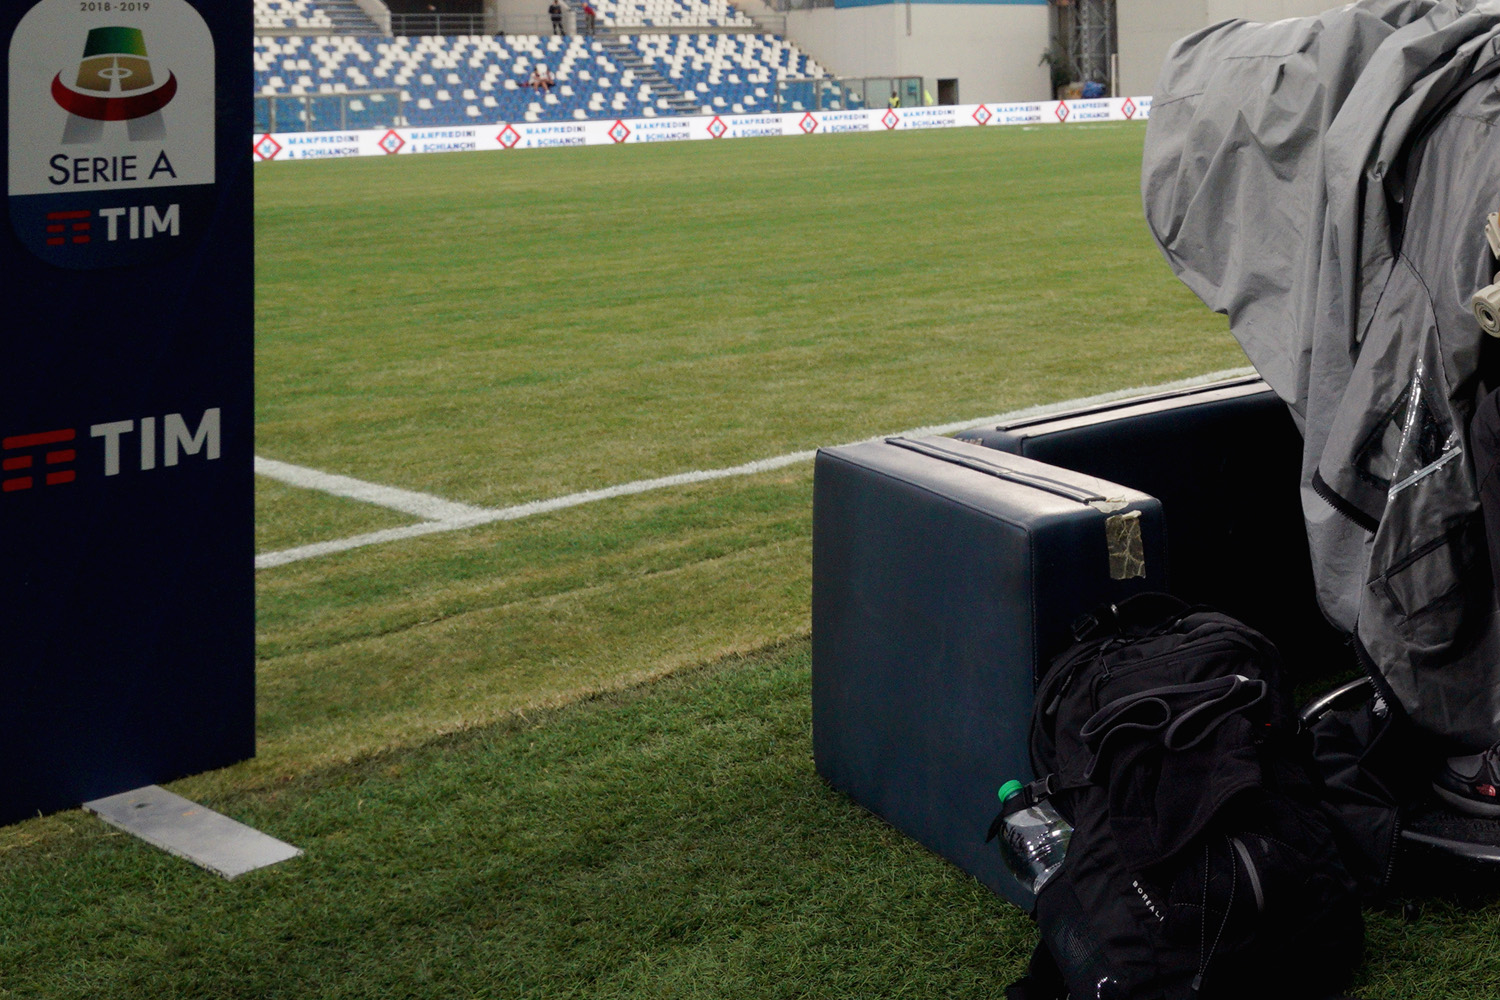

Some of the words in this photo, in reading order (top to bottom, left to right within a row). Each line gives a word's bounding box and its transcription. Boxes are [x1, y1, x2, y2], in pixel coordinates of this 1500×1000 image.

[48, 153, 138, 186] SERIE
[147, 149, 178, 180] A
[98, 203, 180, 242] TIM
[90, 407, 221, 477] TIM
